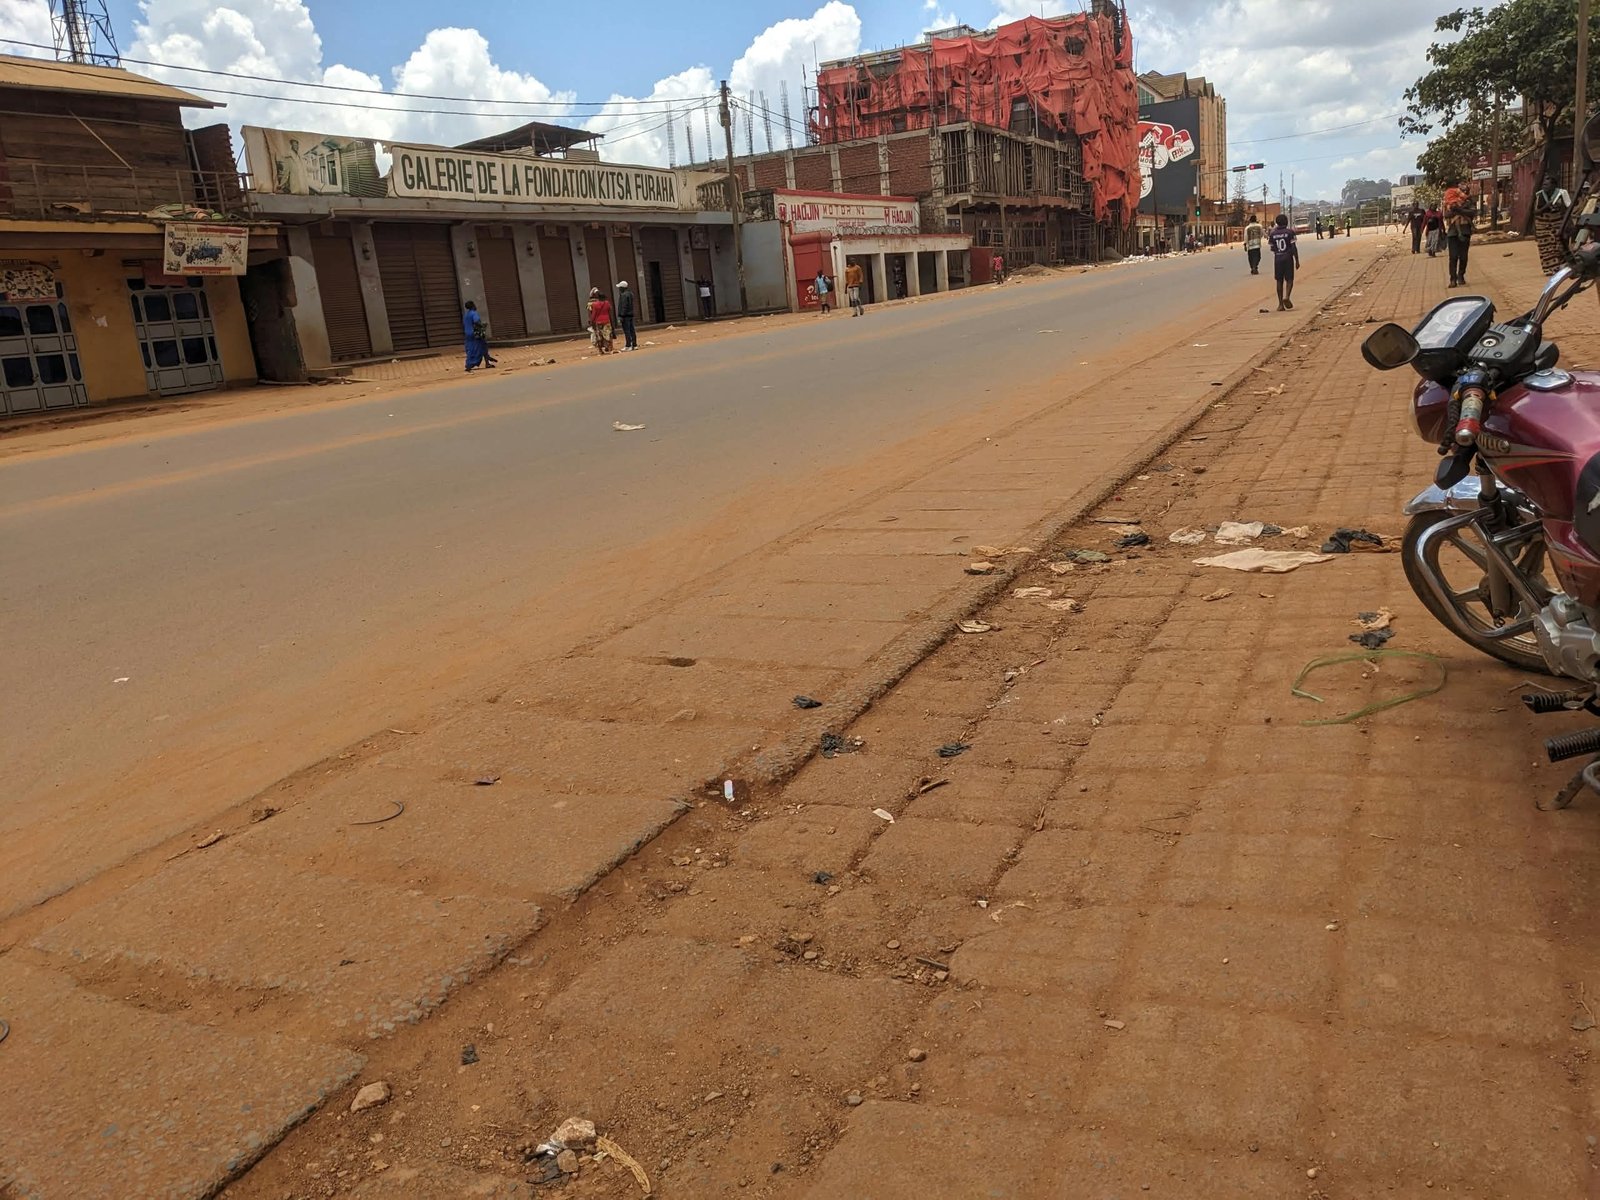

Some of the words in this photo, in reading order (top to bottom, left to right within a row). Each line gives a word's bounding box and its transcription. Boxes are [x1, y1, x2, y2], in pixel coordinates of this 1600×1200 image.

[401, 154, 474, 193] GALERIE
[476, 161, 498, 194] DE
[501, 163, 521, 196] LA
[524, 165, 597, 199] FONDATION
[597, 170, 632, 200] KITSA
[634, 173, 676, 203] FURAHA
[790, 204, 820, 220] HAOJIN
[891, 209, 913, 224] HAOJIN
[1275, 238, 1287, 252] 10
